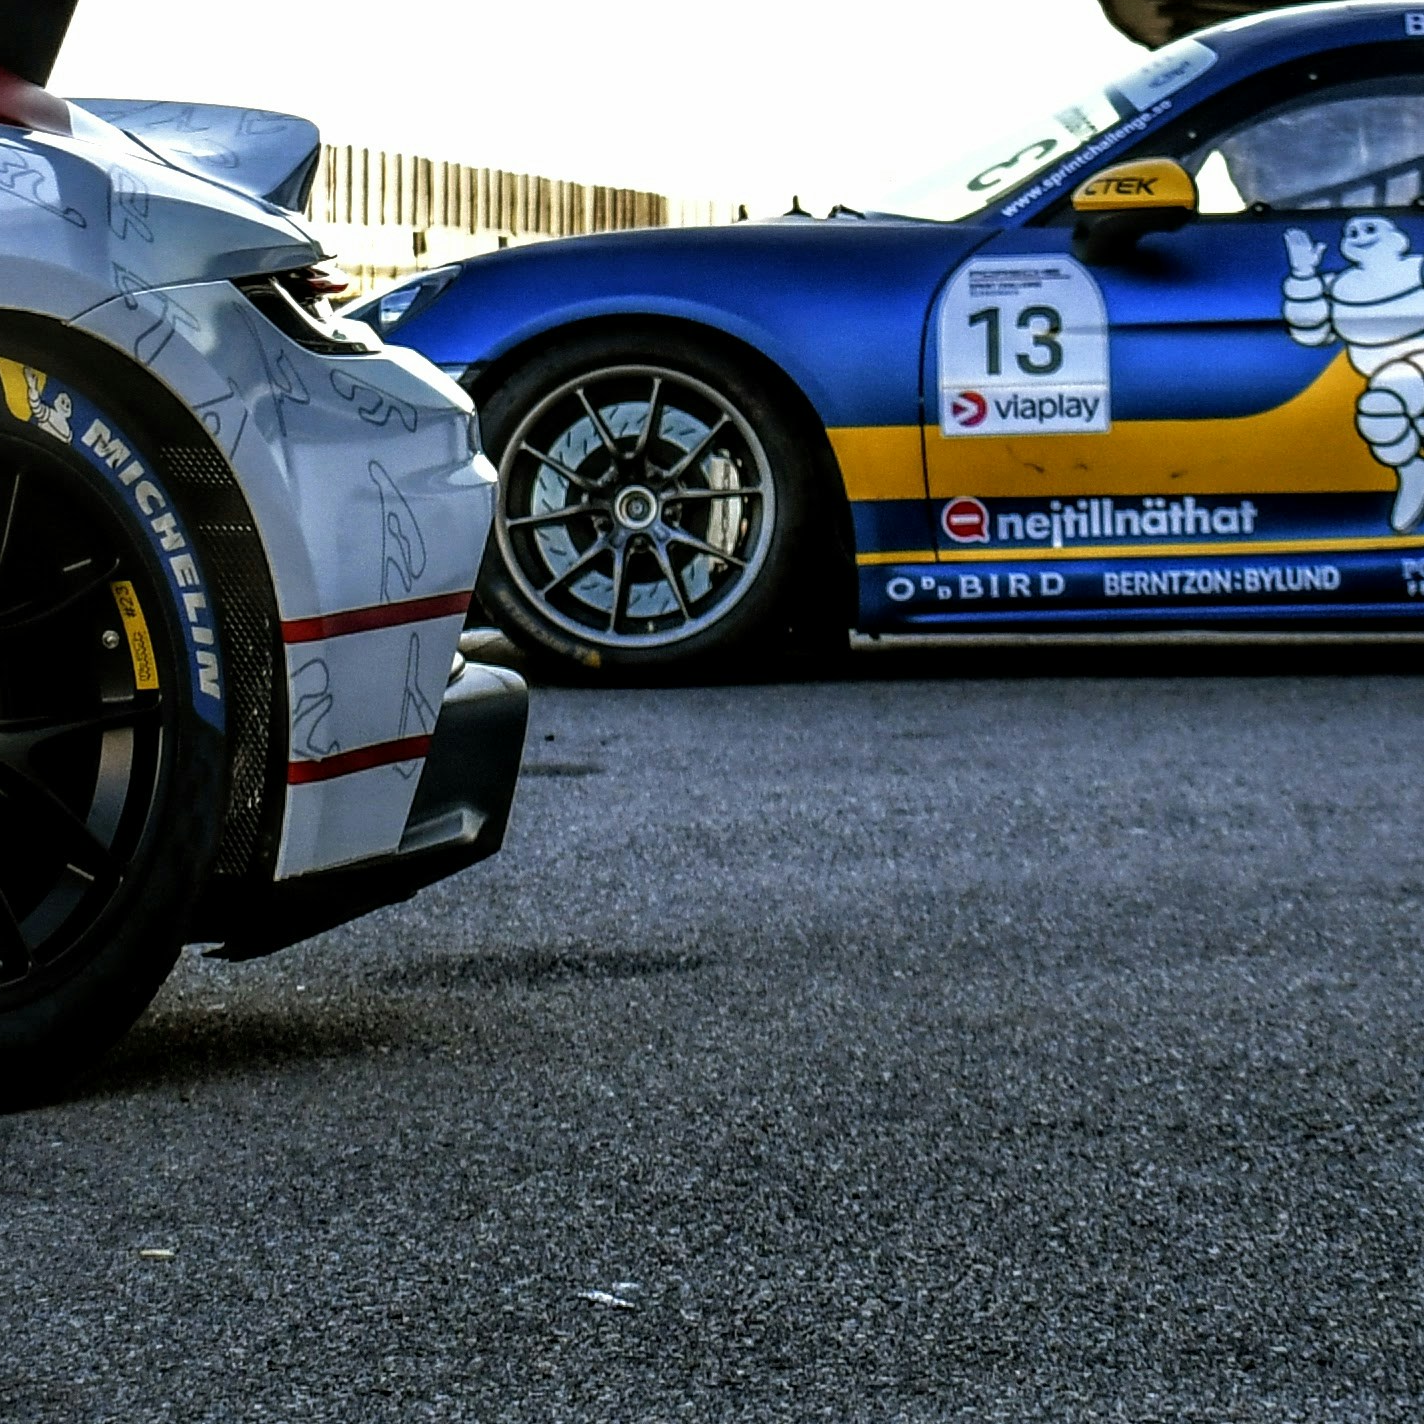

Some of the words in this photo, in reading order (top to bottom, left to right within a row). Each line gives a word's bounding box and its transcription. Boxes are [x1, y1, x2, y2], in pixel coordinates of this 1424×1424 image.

[1000, 100, 1173, 218] www.sprintchallenge.se
[1083, 177, 1160, 197] CTEK
[968, 304, 1065, 378] 13
[994, 392, 1101, 425] viaplay
[997, 495, 1259, 549] nejtillnäthat
[81, 418, 221, 700] MICHELIN
